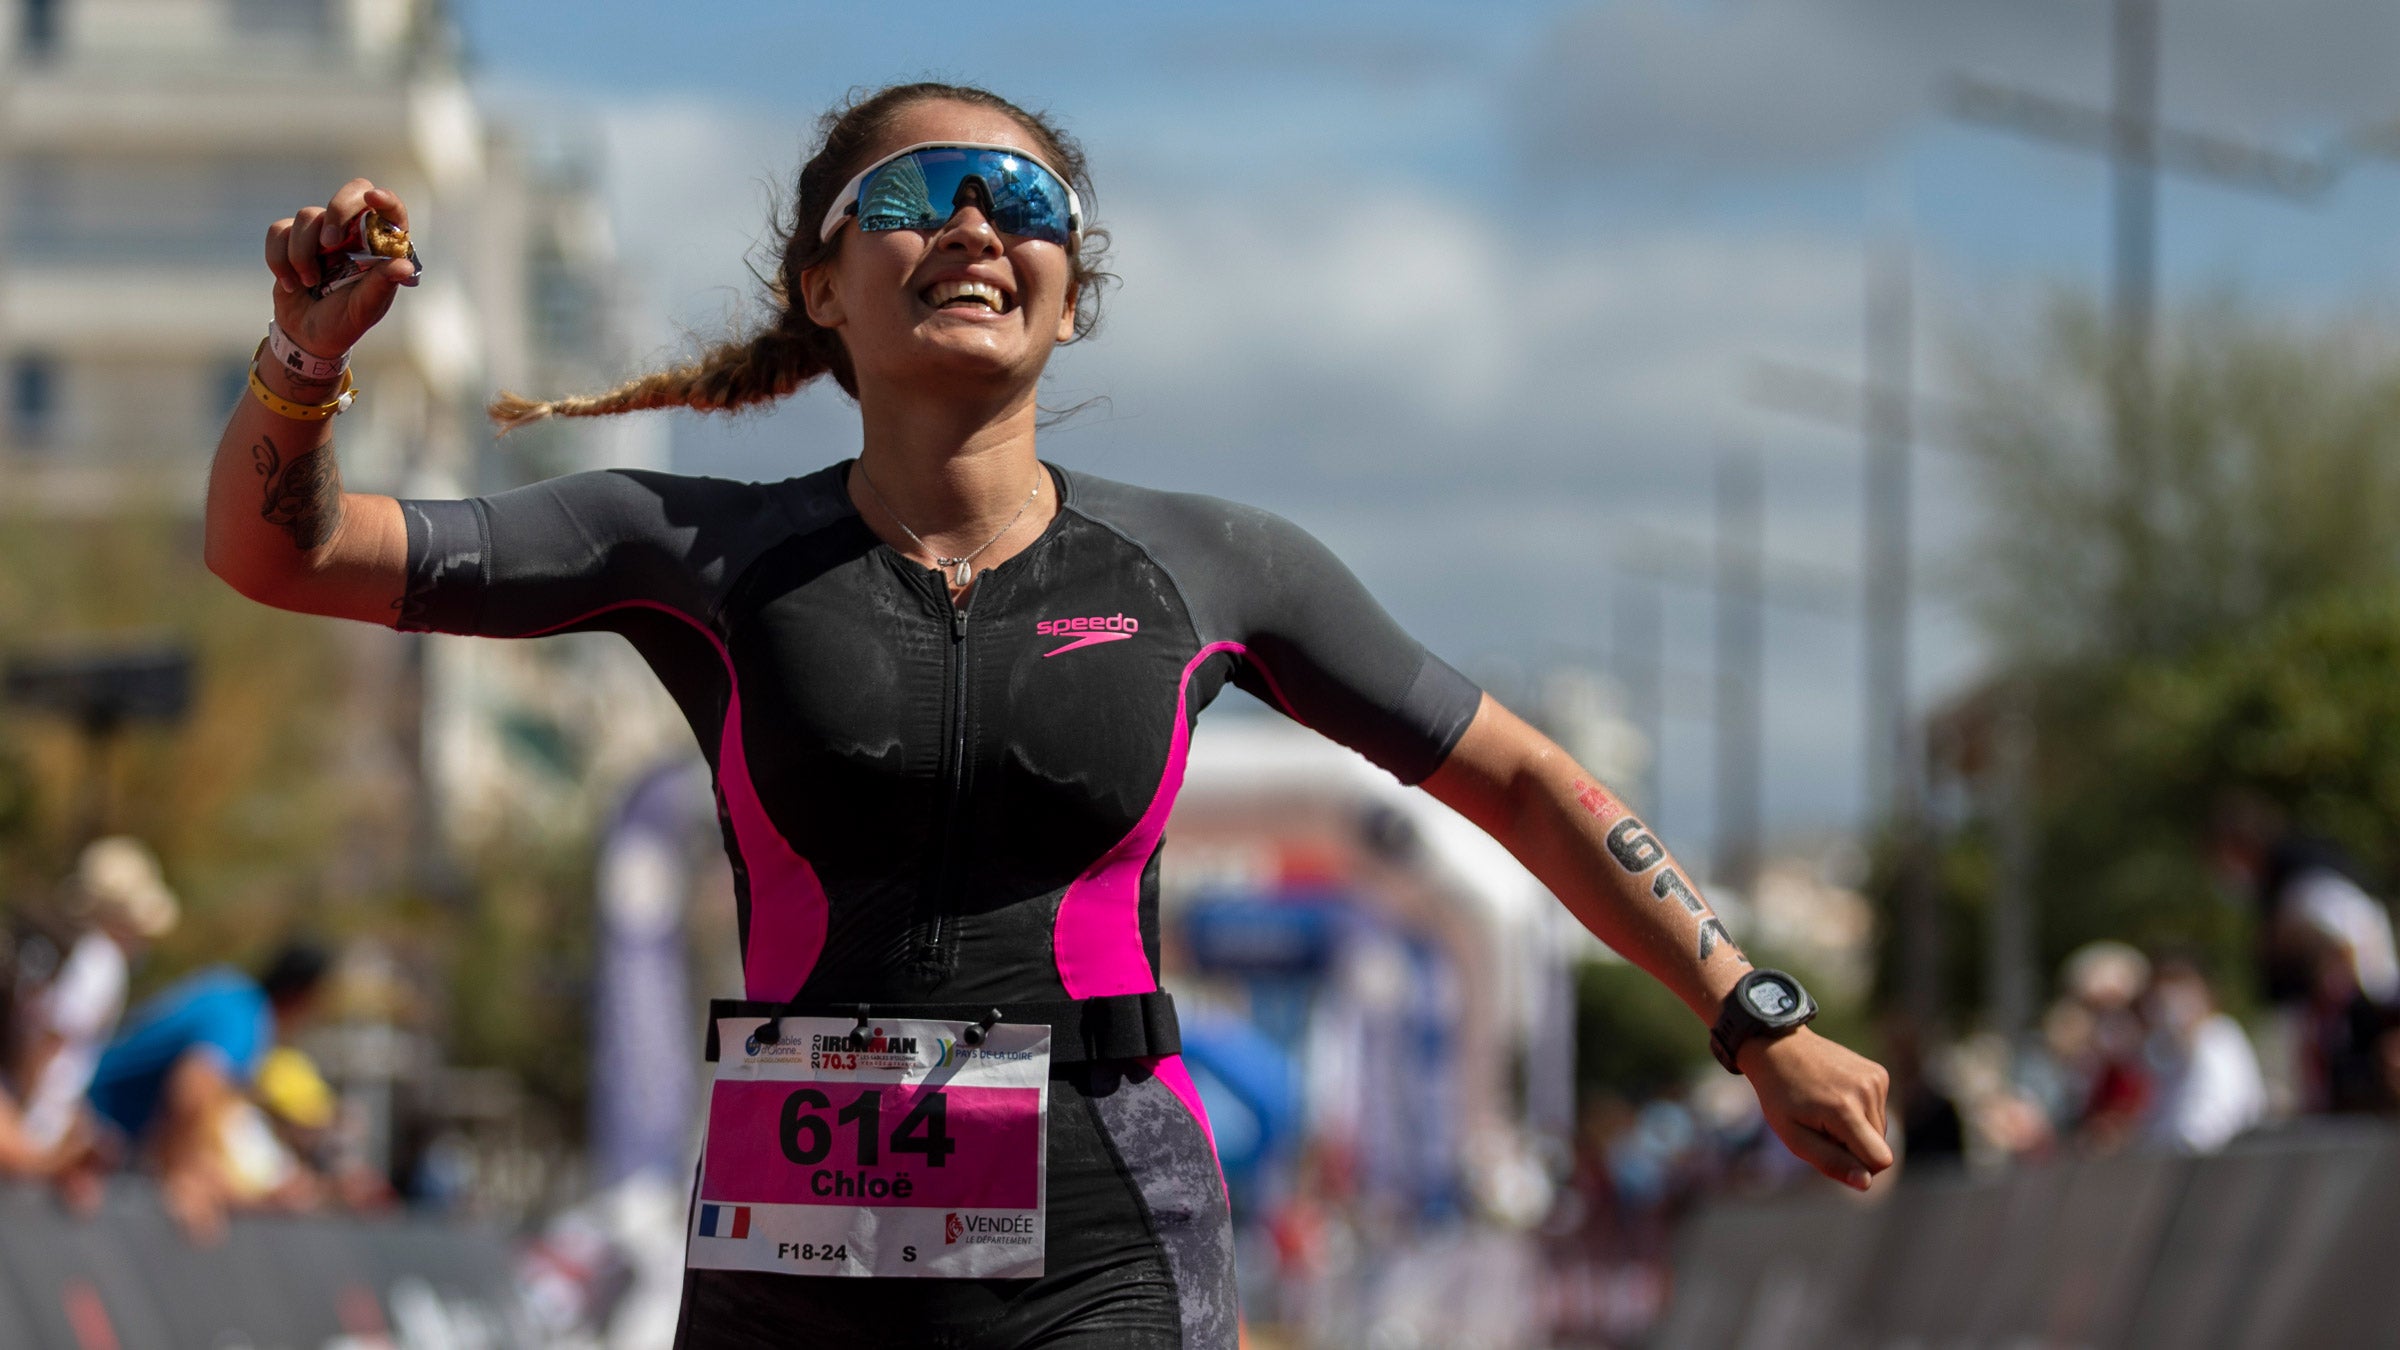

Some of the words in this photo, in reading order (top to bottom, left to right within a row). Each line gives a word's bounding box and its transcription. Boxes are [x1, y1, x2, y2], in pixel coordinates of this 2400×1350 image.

[1037, 612, 1139, 636] speedo
[811, 1034, 822, 1069] 2020
[955, 1048, 978, 1059] PAYS
[980, 1049, 992, 1059] DE
[994, 1050, 1006, 1060] LA
[1007, 1051, 1033, 1061] LOIRE
[822, 1053, 858, 1070] 70.3
[779, 1088, 956, 1168] 614
[810, 1169, 914, 1198] Chloë
[965, 1214, 1034, 1234] VENDÉE
[965, 1236, 975, 1244] LE
[976, 1235, 1033, 1245] DÉPARTEMENT
[777, 1243, 848, 1261] F18-24
[902, 1245, 918, 1262] S
